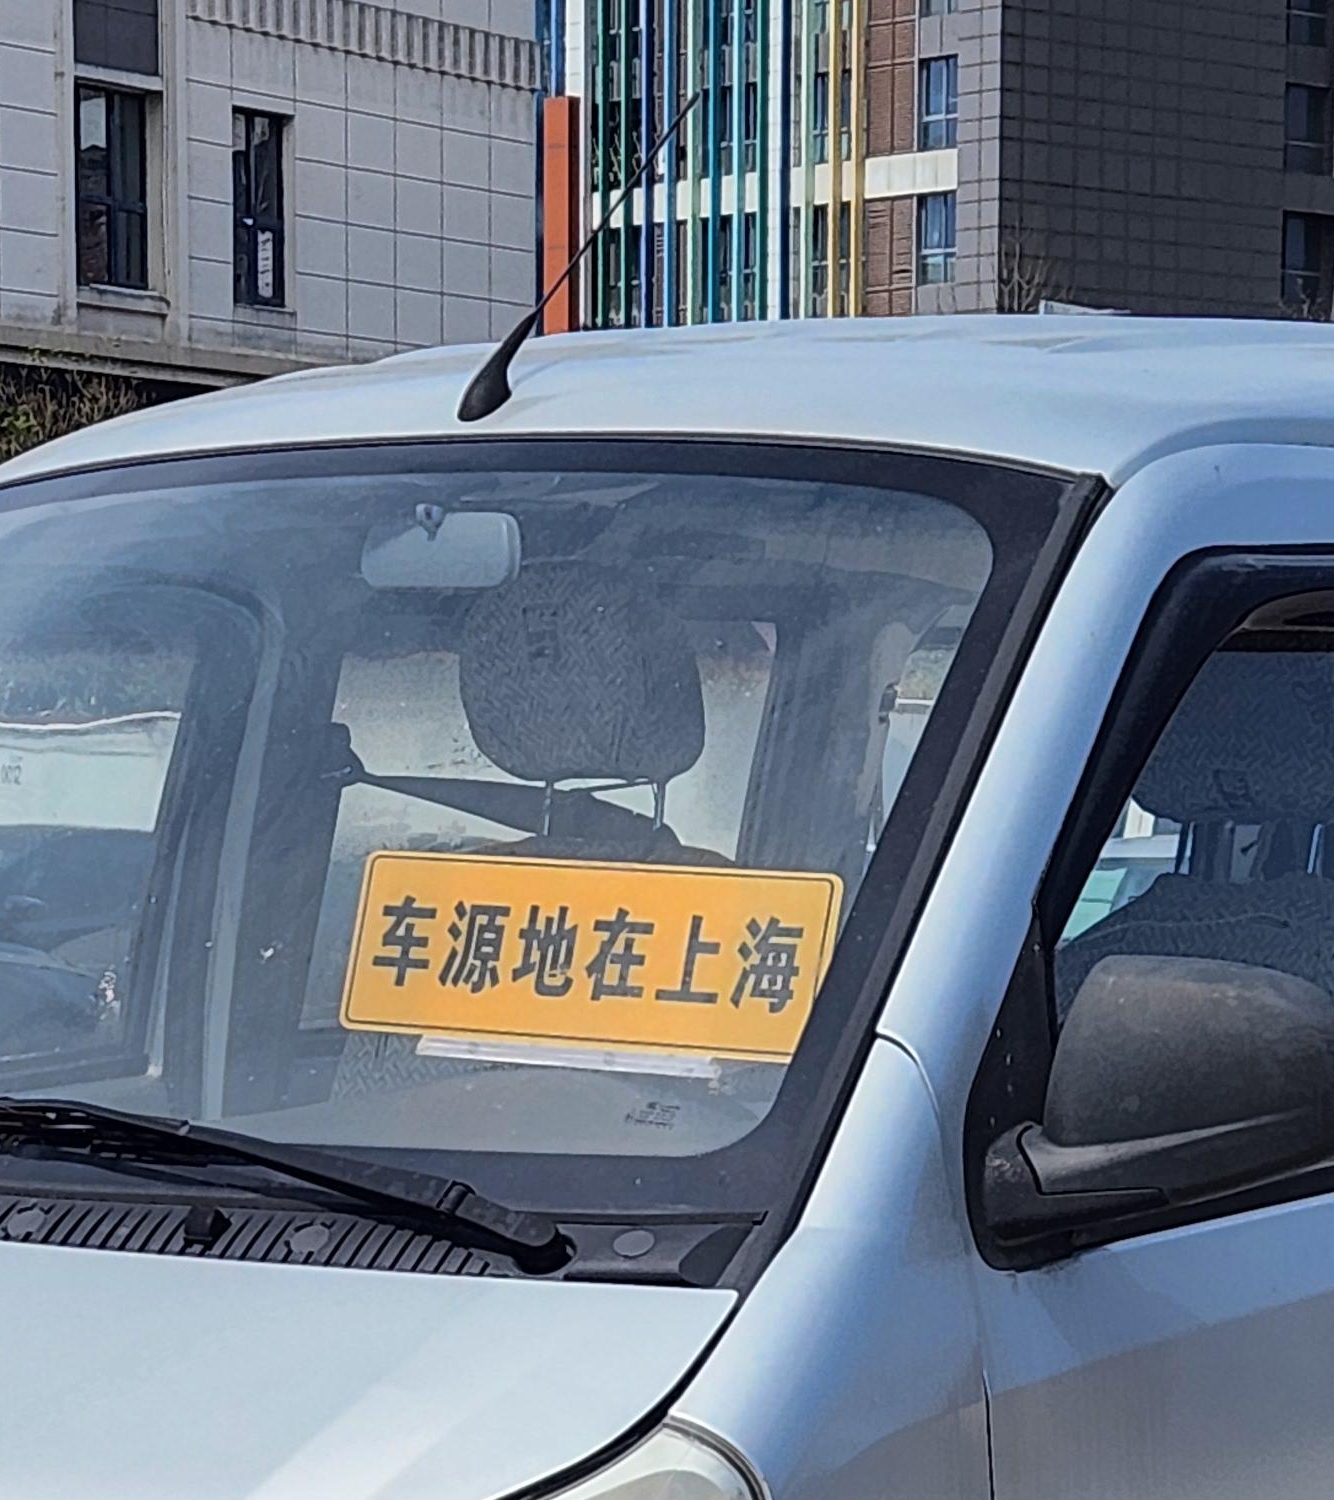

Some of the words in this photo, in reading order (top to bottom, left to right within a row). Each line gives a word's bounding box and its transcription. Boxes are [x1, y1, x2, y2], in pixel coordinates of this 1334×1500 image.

[372, 895, 805, 1014] 车源地在上海
